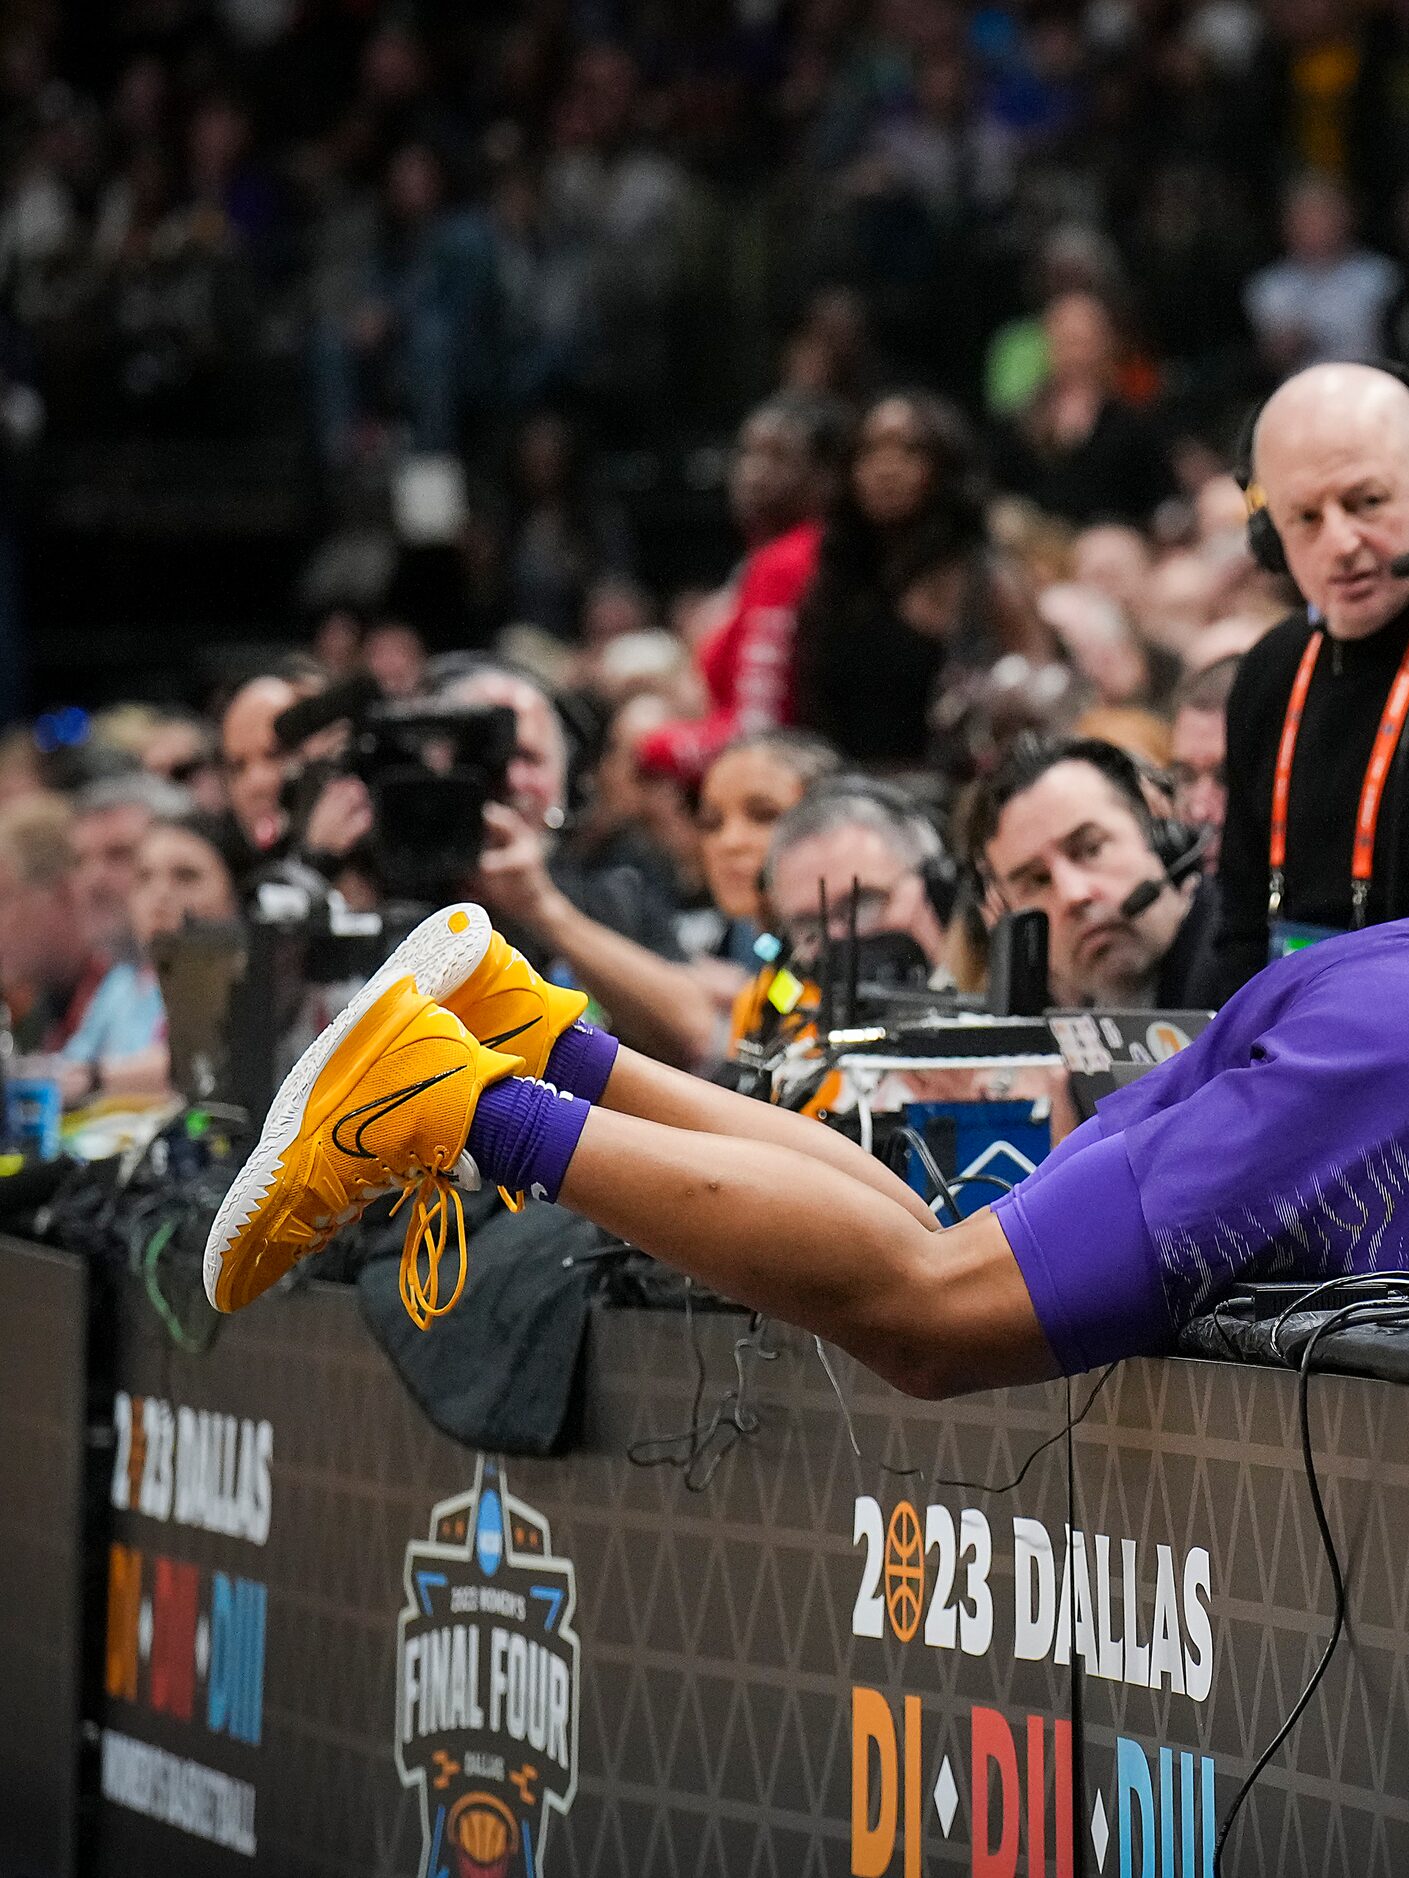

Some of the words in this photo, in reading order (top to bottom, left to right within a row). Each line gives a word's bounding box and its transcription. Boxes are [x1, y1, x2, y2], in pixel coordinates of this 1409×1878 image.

[404, 1624, 485, 1744] FINAL
[490, 1626, 570, 1771] FOUR
[1013, 1516, 1213, 1703] DALLAS
[851, 1685, 922, 1878] DI
